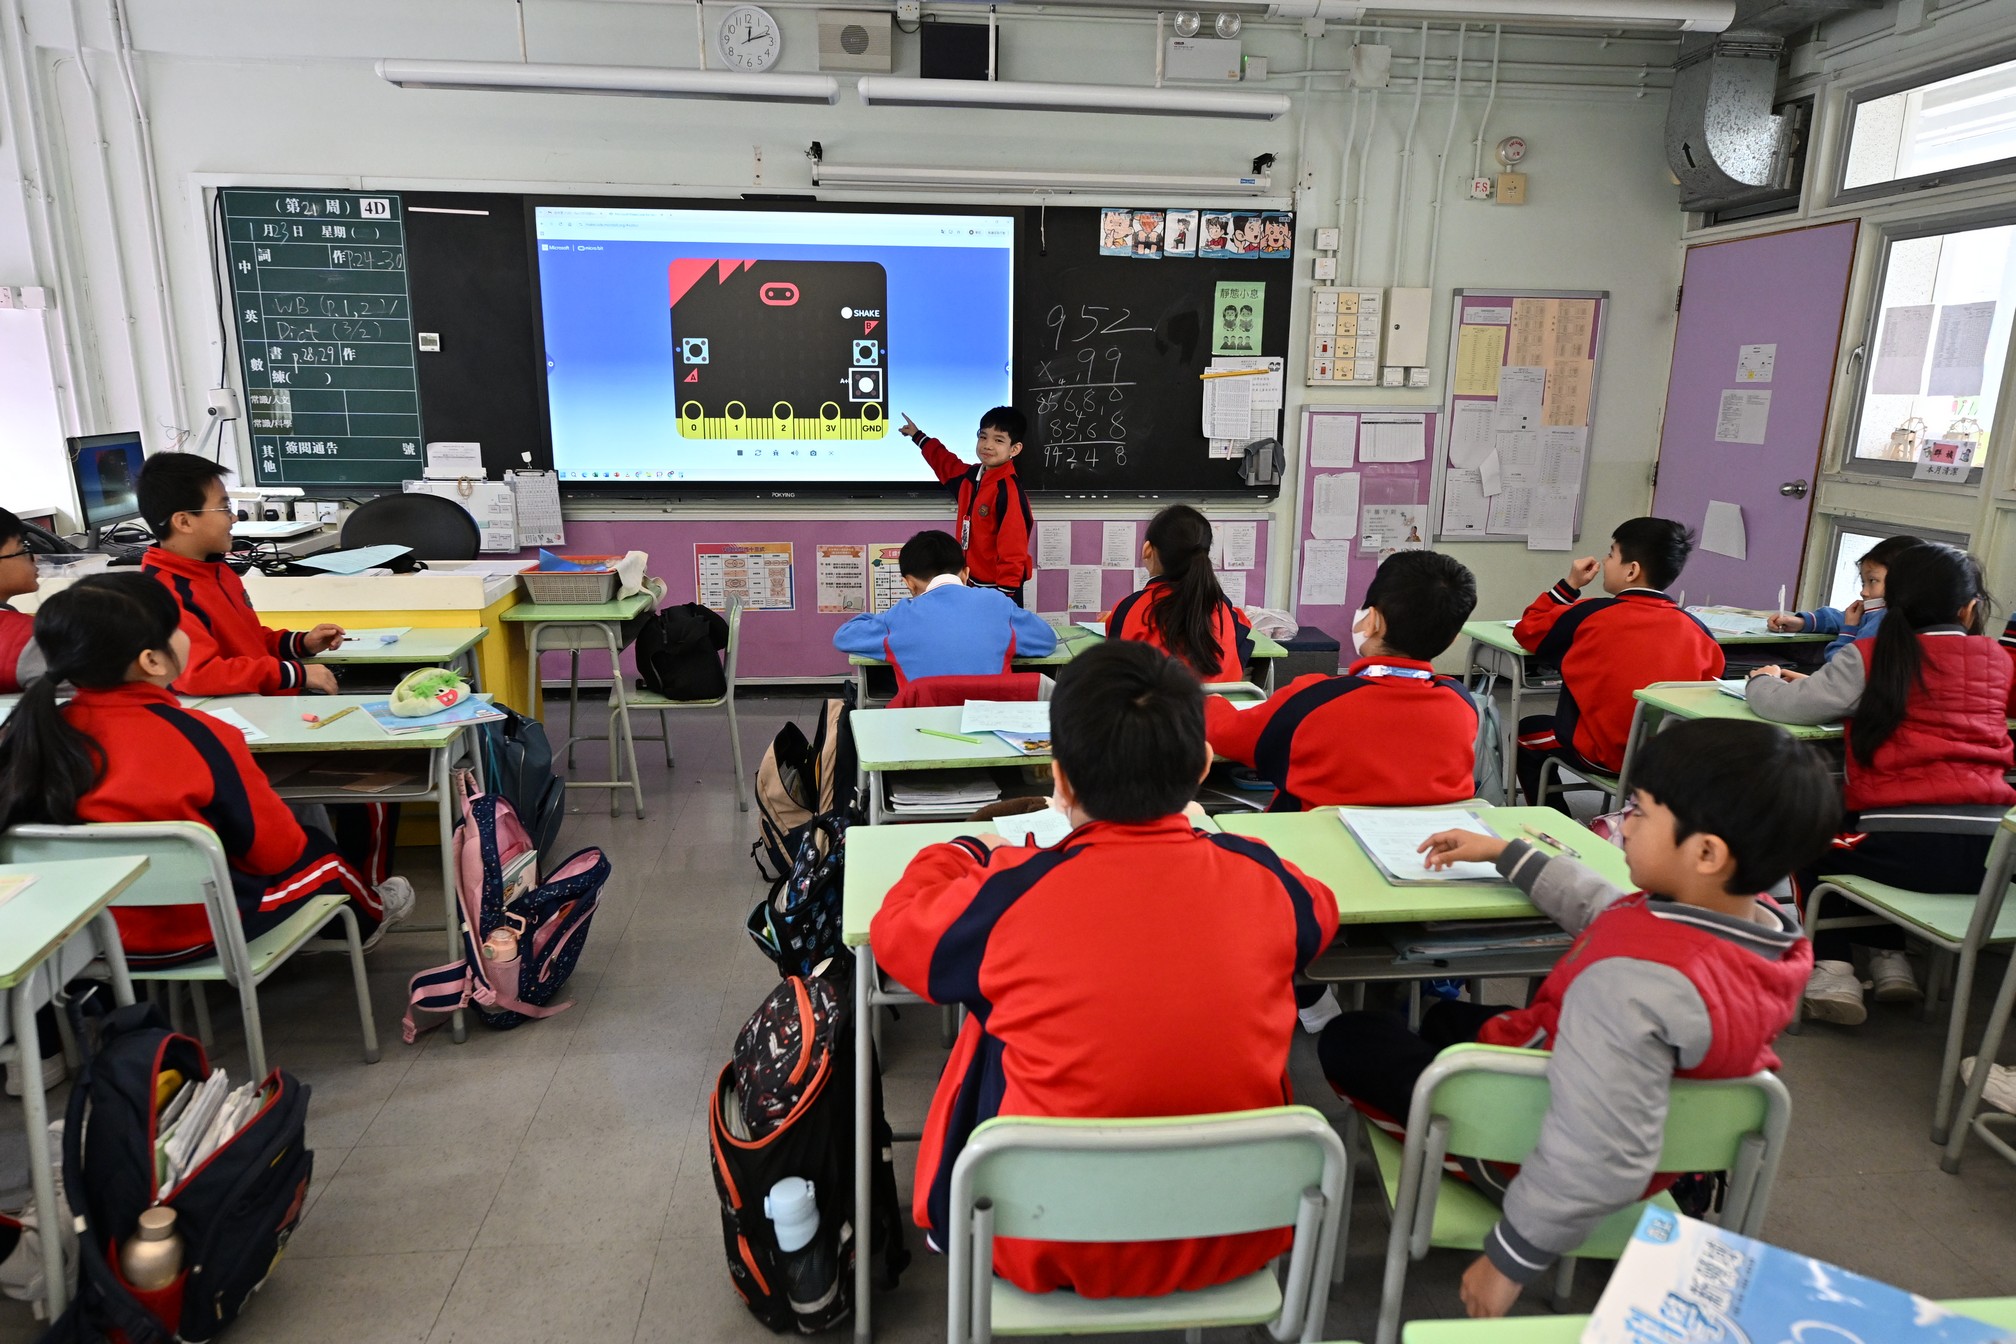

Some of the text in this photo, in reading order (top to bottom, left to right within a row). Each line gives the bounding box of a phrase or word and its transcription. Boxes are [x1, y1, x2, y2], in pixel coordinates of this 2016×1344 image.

[736, 16, 741, 26] 11
[745, 14, 752, 24] 12
[728, 24, 736, 34] 10
[764, 25, 770, 35] 2
[724, 35, 730, 44] 9
[769, 36, 774, 46] 3
[728, 46, 734, 56] 8
[764, 48, 770, 58] 4
[737, 54, 744, 64] 7
[746, 58, 752, 68] 6
[758, 56, 763, 66] 5
[364, 202, 386, 215] 4D
[258, 248, 272, 262] 詞
[333, 250, 346, 264] 作
[238, 260, 252, 274] 中
[1220, 288, 1258, 299] 靜態小息
[274, 296, 309, 315] WB
[244, 309, 259, 324] 英
[866, 322, 872, 330] B
[1047, 304, 1152, 350] 952
[277, 322, 319, 342] Dict
[343, 348, 356, 361] 作
[250, 358, 264, 372] 數
[1077, 348, 1122, 384] 99
[690, 374, 696, 382] A
[250, 394, 290, 404] 常識/人文
[253, 419, 293, 428] 常識/科學
[691, 424, 882, 432] 0 1 2 3V GND
[284, 442, 416, 456] 簽閱通告 號
[262, 445, 277, 473] 其他
